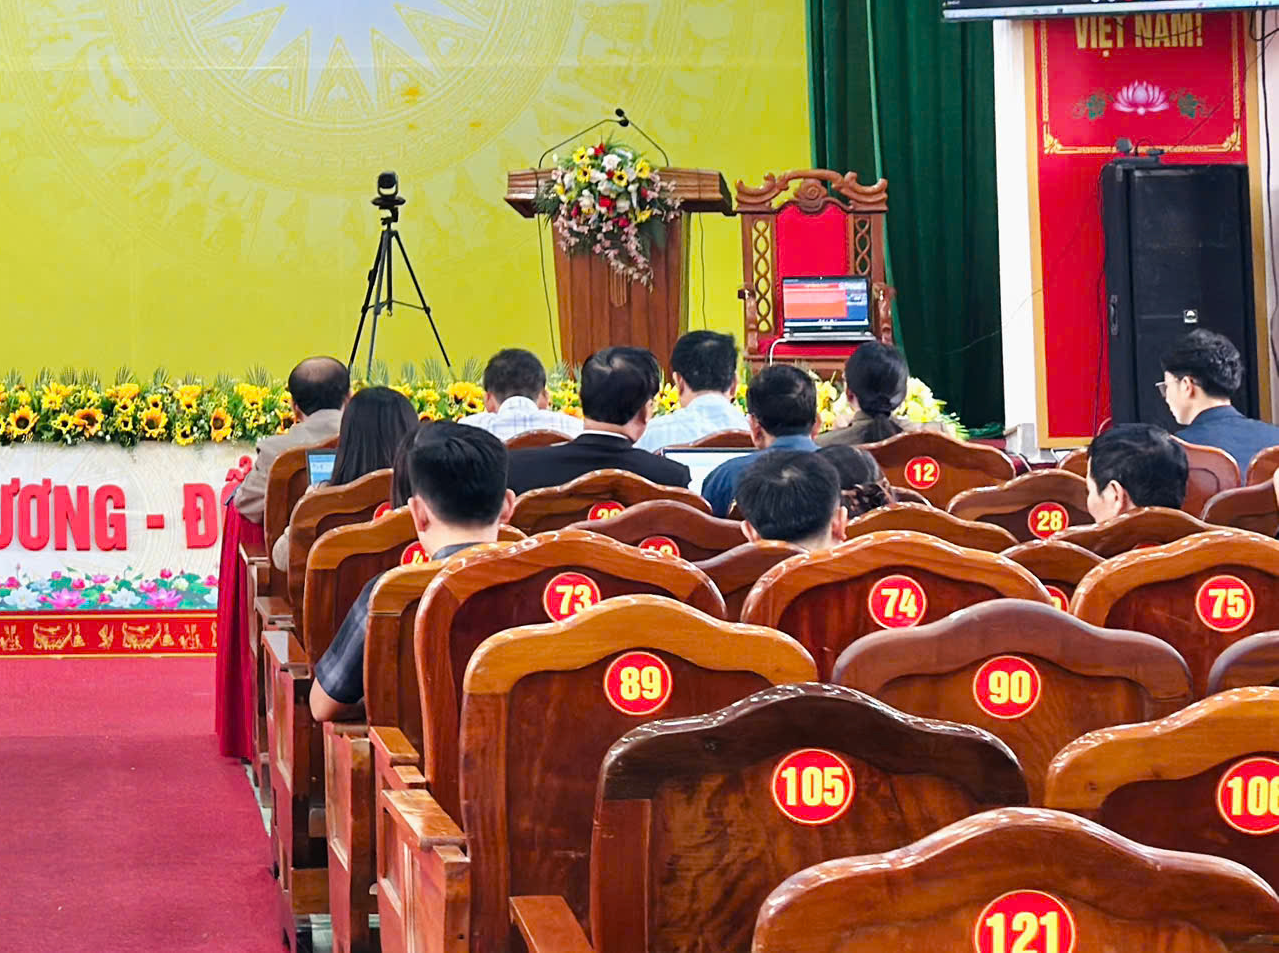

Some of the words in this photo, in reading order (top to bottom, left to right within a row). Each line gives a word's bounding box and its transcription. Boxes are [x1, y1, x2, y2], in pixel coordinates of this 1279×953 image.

[1134, 13, 1203, 48] NAM!
[912, 463, 935, 482] 12
[146, 514, 164, 529] -
[1037, 510, 1063, 531] 28
[555, 583, 591, 614] 73
[881, 587, 917, 617] 74
[1209, 589, 1246, 618] 75
[620, 665, 661, 700] 89
[989, 671, 1030, 703] 90
[781, 766, 845, 808] 105
[986, 911, 1058, 953] 121
